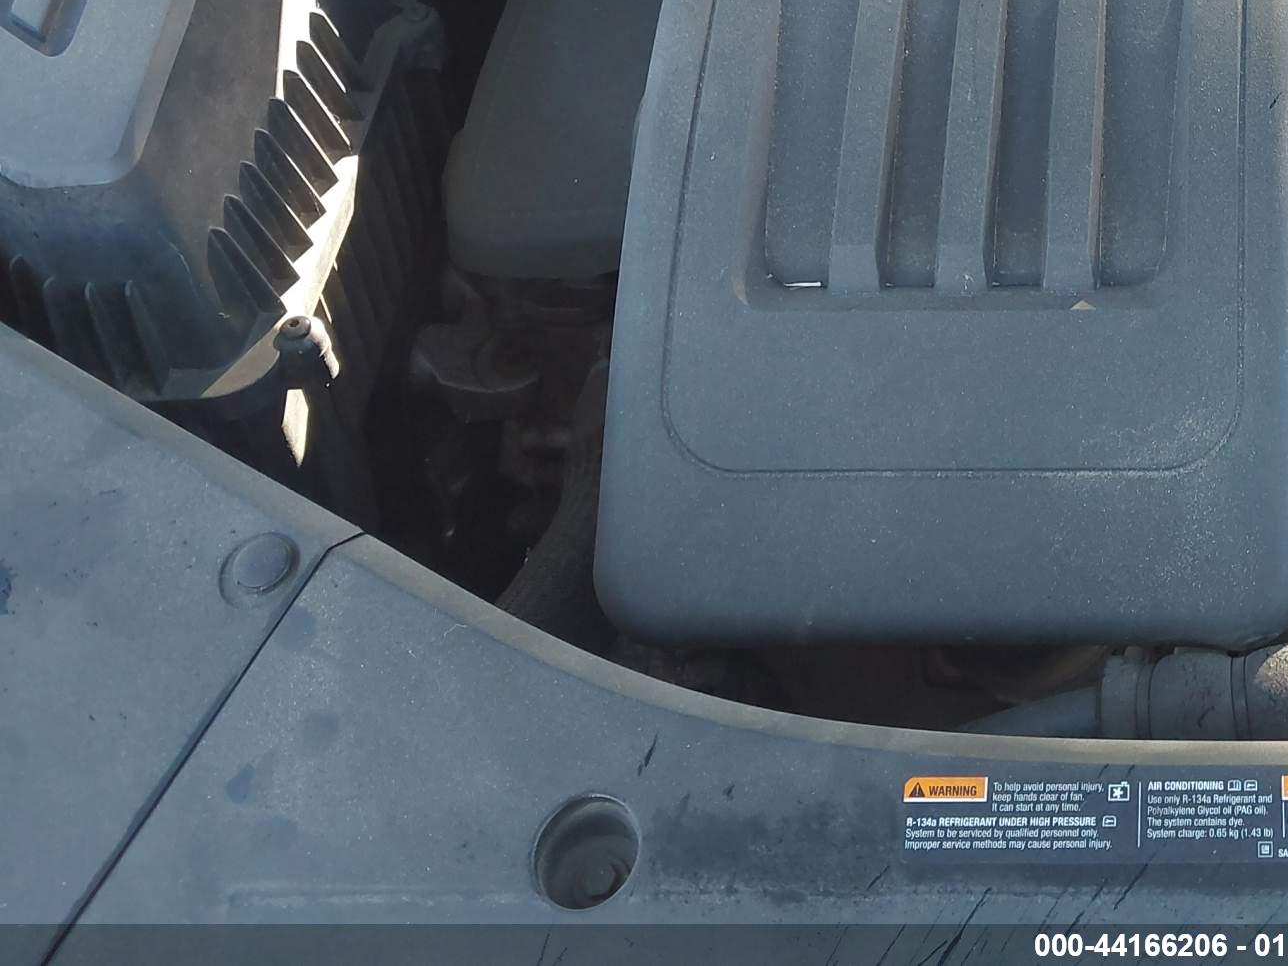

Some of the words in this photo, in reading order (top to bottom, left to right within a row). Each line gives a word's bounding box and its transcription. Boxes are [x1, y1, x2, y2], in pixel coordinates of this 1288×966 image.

[929, 786, 977, 796] WARNING
[993, 782, 1002, 791] To
[1004, 782, 1020, 793] help
[1023, 782, 1043, 792] avoid
[1046, 782, 1078, 792] personal
[1148, 781, 1162, 791] AIR
[1164, 781, 1224, 791] CONDITIONING
[993, 793, 1011, 803] keep
[1014, 793, 1037, 802] hands
[1040, 792, 1058, 802] clear
[1060, 792, 1068, 801] of
[1148, 794, 1162, 804] Use
[1164, 794, 1180, 804] only
[1182, 794, 1210, 804] R-134a
[1213, 794, 1256, 804] Refrigerant
[1258, 794, 1272, 803] and
[992, 803, 998, 812] It
[999, 804, 1013, 812] can
[1016, 803, 1033, 812] start
[1035, 803, 1043, 812] at
[1045, 804, 1060, 814] any
[1062, 803, 1080, 812] time.
[1148, 806, 1195, 816] Polyalkylene
[1197, 805, 1220, 816] Glycol
[1222, 805, 1232, 814] oil
[1234, 805, 1252, 816] (PAG
[906, 817, 936, 826] R-134a
[939, 817, 997, 826] REFRIGERANT
[999, 817, 1028, 826] UNDER
[1030, 817, 1050, 826] HIGH
[1052, 817, 1096, 826] PRESSURE
[1147, 817, 1161, 826] The
[1164, 818, 1192, 827] system
[1194, 816, 1226, 826] contains
[906, 828, 934, 840] System
[937, 829, 944, 838] to
[946, 829, 956, 838] be
[958, 829, 992, 838] serviced
[994, 829, 1003, 839] by
[1005, 828, 1039, 838] qualified
[1041, 829, 1079, 839] personnel
[1146, 828, 1176, 839] System
[1178, 828, 1207, 840] charge:
[1209, 828, 1227, 838] 0.65
[1229, 828, 1238, 840] kg
[1241, 827, 1261, 839] (1.43
[1263, 827, 1274, 839] lb)
[904, 840, 940, 850] Improper
[942, 840, 970, 849] service
[972, 840, 1006, 849] methods
[1009, 840, 1026, 850] may
[1027, 840, 1051, 849] cause
[1053, 839, 1086, 850] personal
[1088, 838, 1112, 850] injury.
